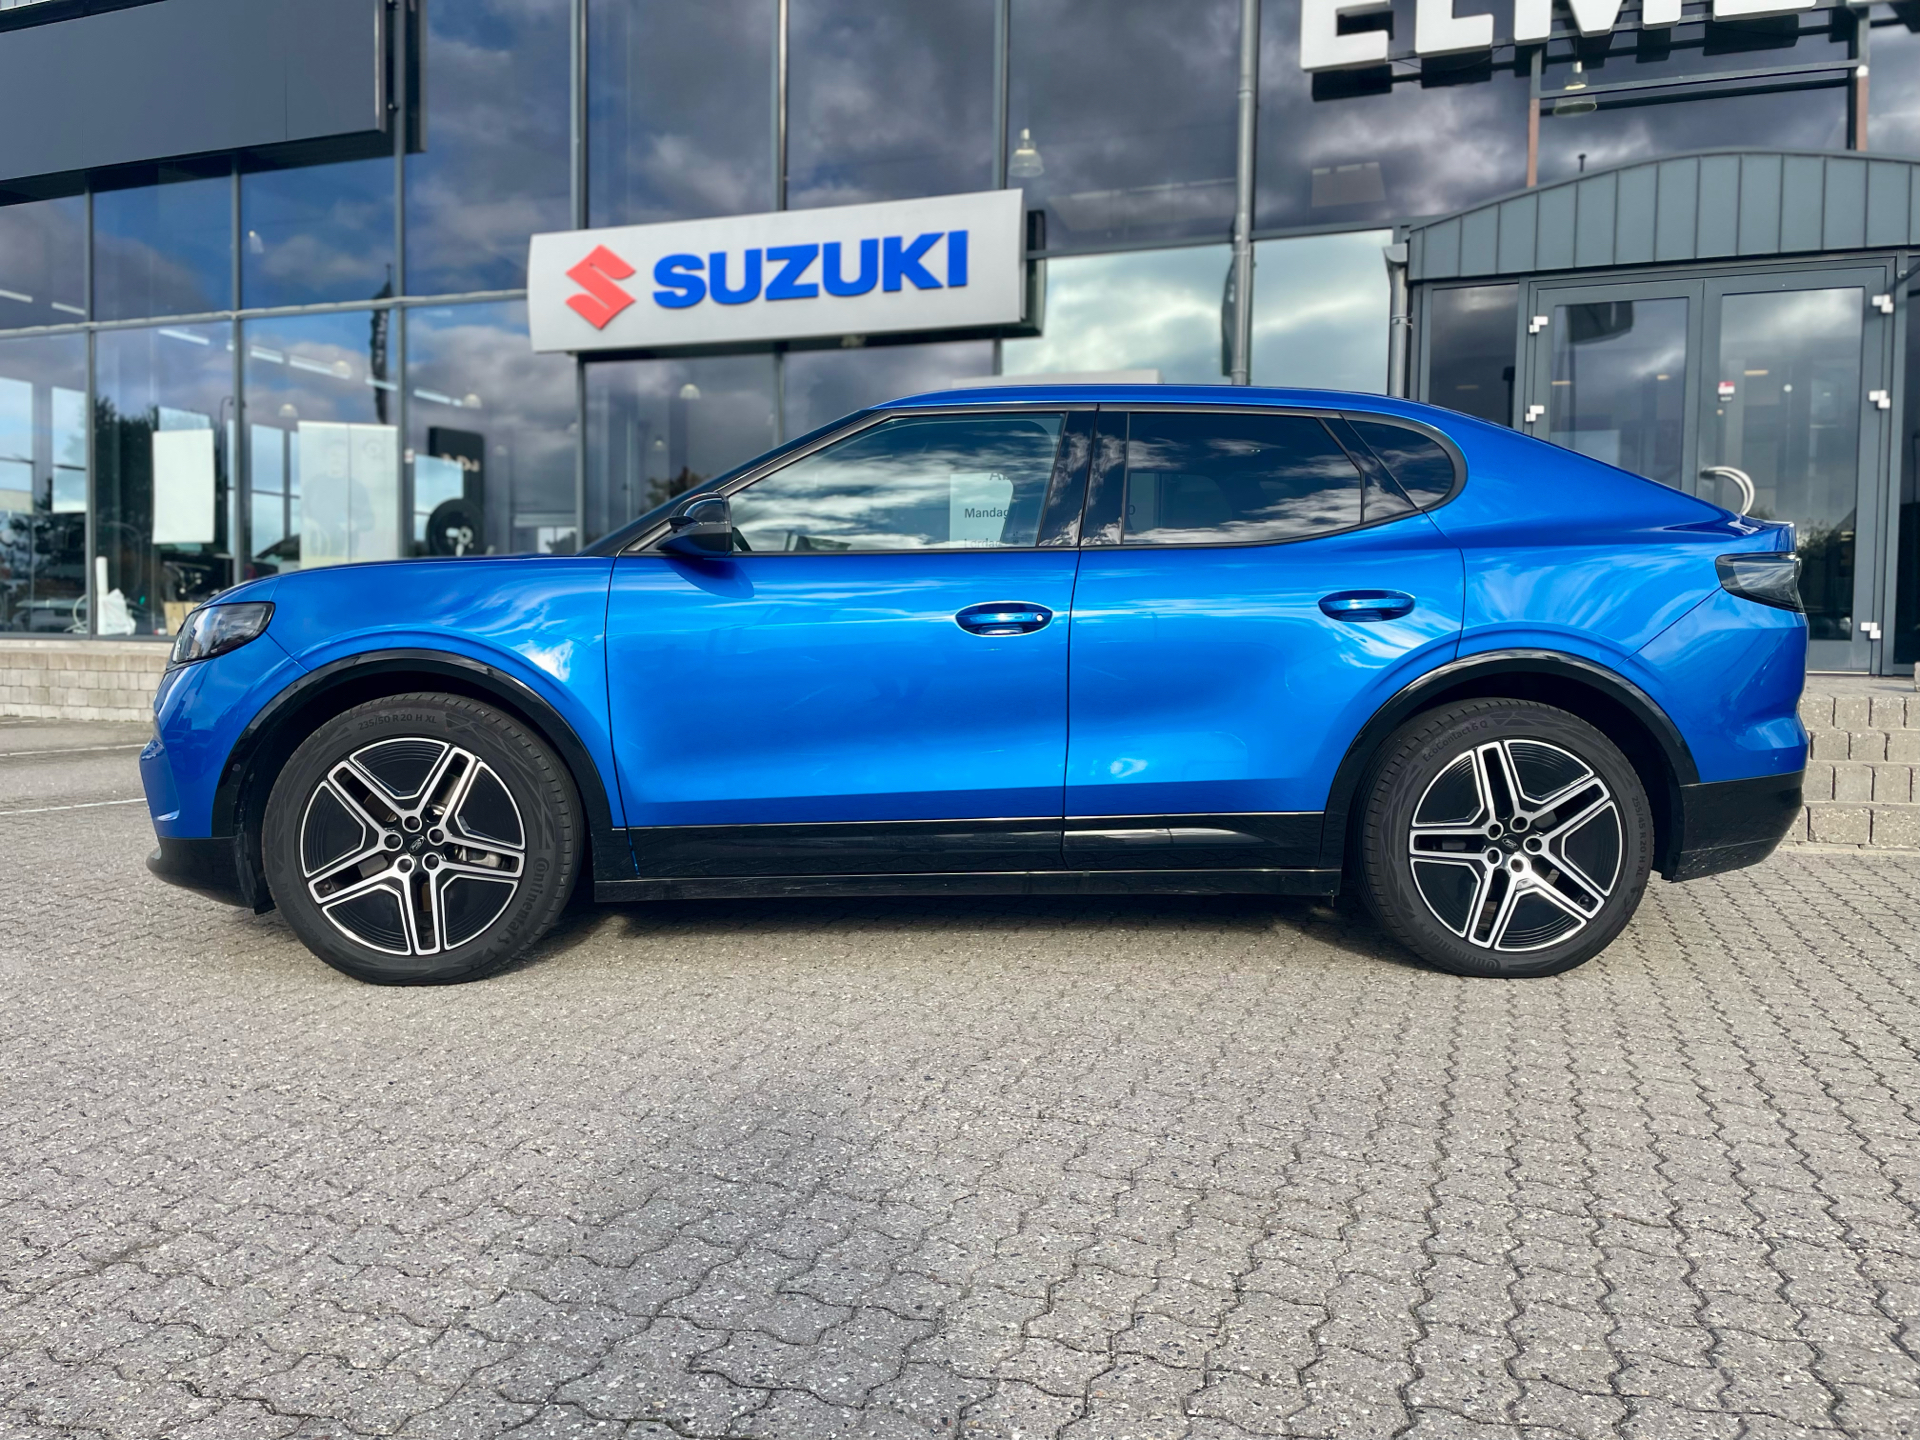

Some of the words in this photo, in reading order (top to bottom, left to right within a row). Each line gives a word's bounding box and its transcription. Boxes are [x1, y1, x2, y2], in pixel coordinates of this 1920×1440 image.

[653, 230, 968, 309] SUZUKI
[964, 507, 1008, 520] Mandag
[358, 715, 391, 730] 235/50
[415, 714, 423, 722] H
[425, 714, 437, 724] XL
[1422, 725, 1472, 762] EcoContact
[1631, 796, 1646, 829] 255/45
[1635, 865, 1644, 878] XL
[505, 857, 550, 937] Continental
